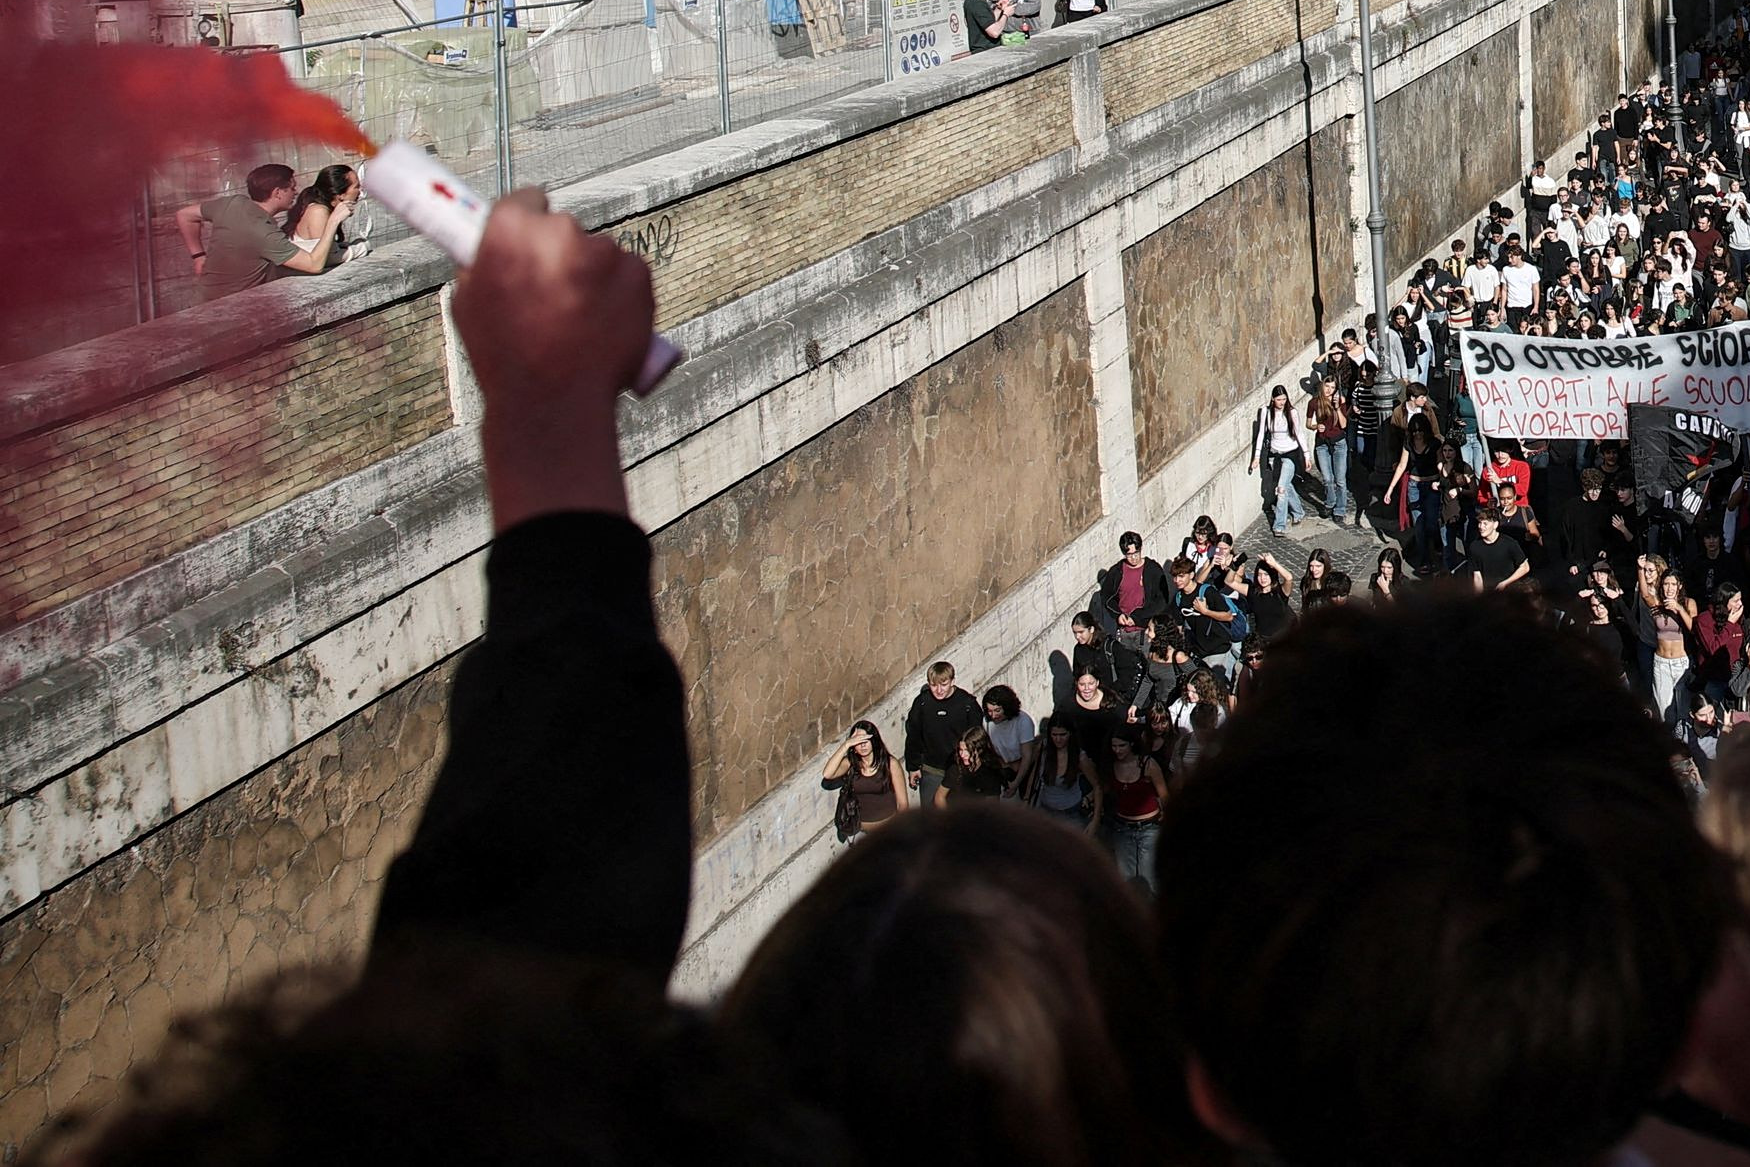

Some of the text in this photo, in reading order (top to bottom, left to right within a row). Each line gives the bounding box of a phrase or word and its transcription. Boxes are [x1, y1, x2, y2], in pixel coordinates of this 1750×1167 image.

[1467, 338, 1515, 375] 30
[1524, 342, 1663, 371] OTTOBRE
[1607, 374, 1670, 407] ALLE
